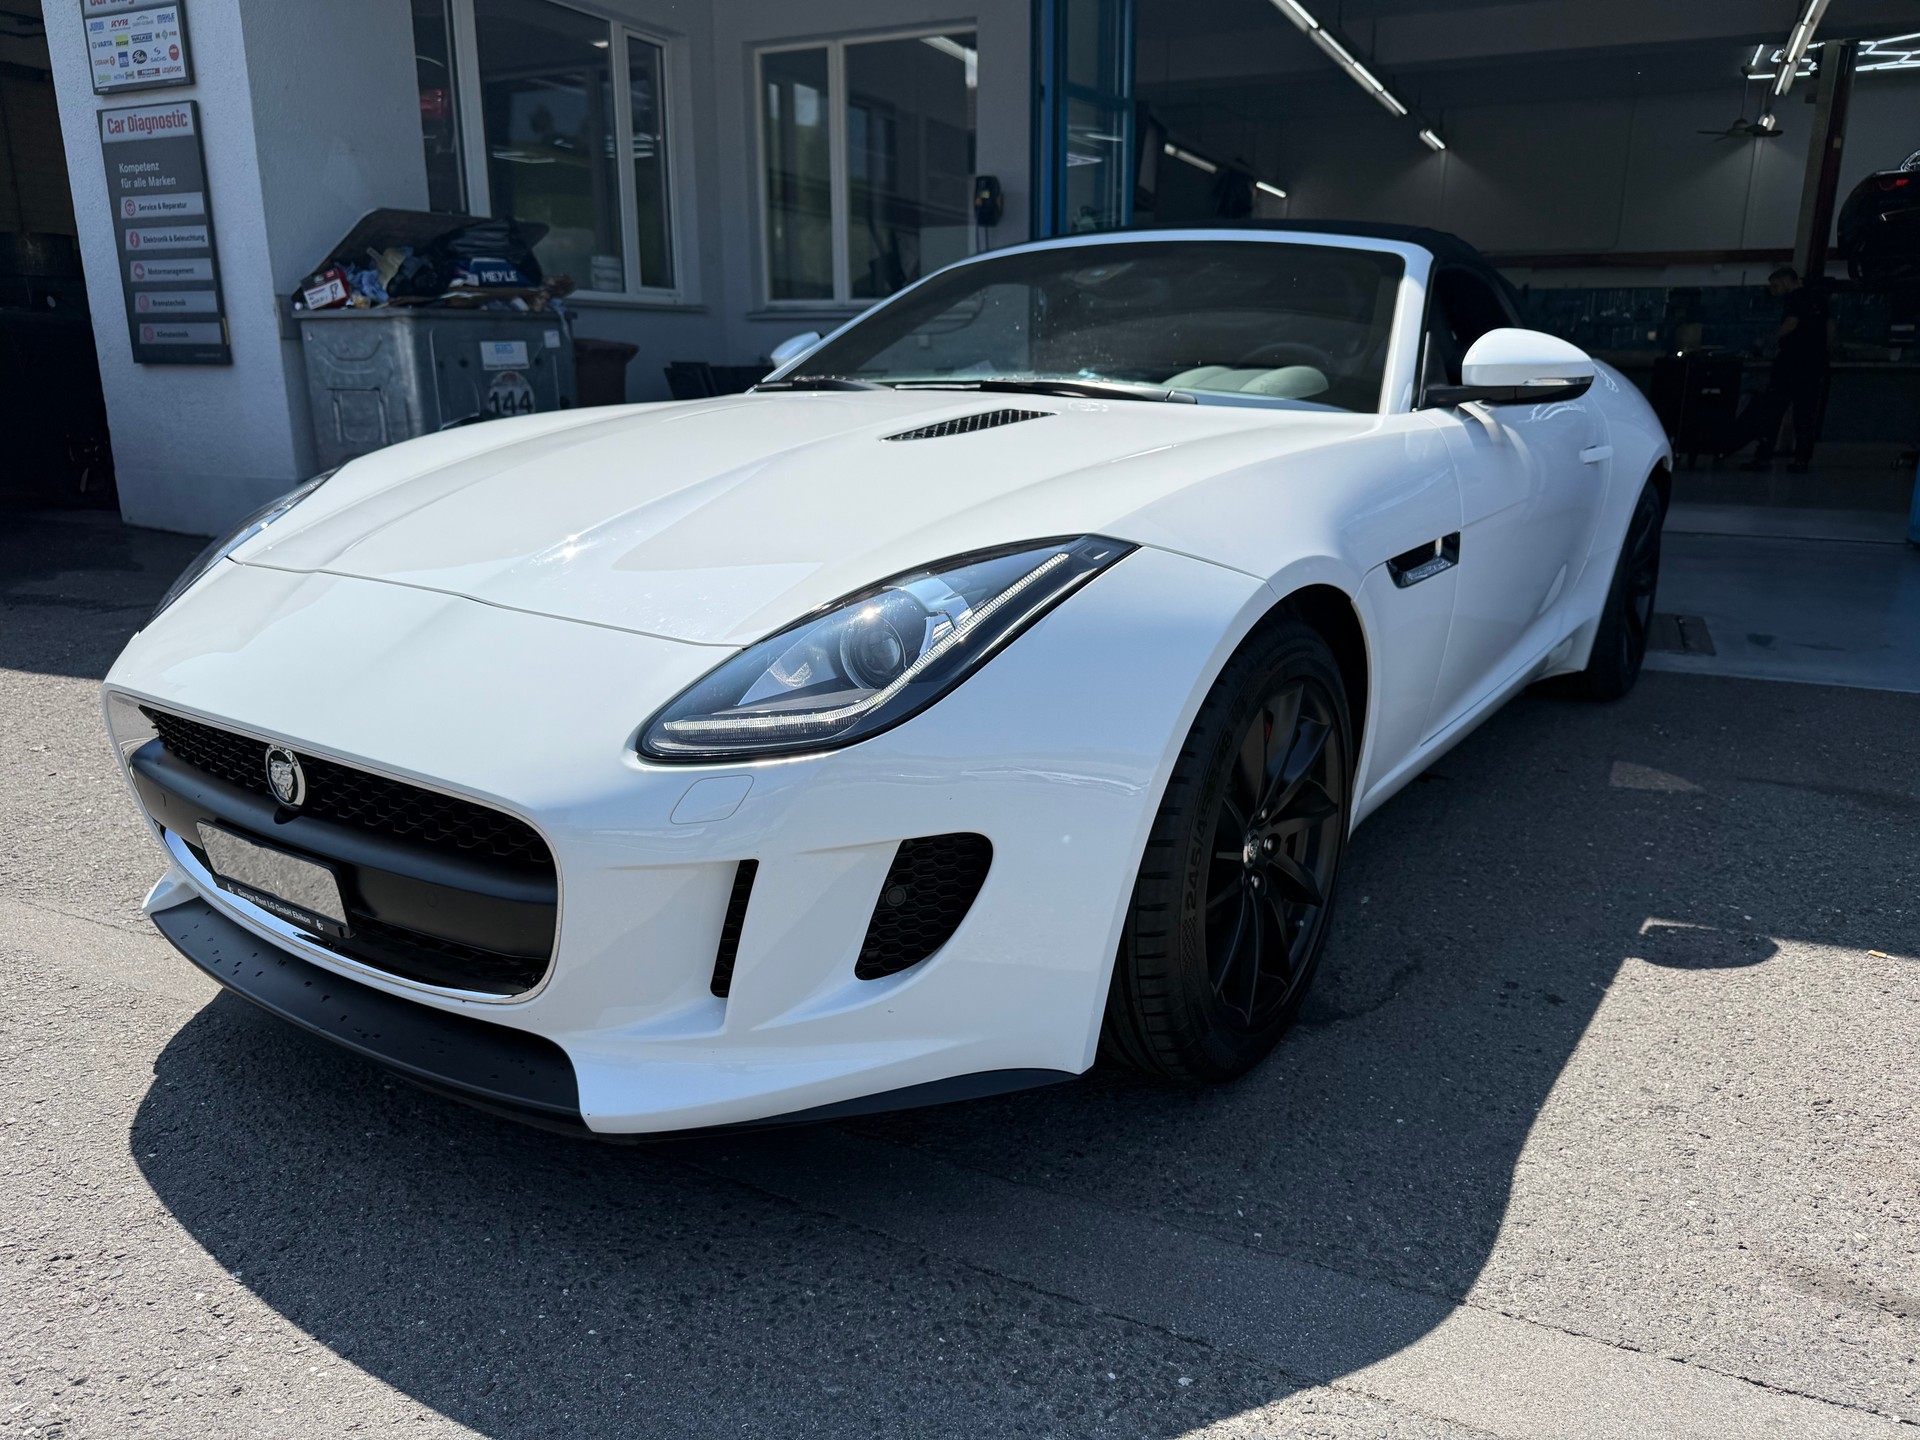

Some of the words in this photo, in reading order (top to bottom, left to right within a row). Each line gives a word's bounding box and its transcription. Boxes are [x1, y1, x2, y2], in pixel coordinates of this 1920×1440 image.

[97, 40, 113, 48] VARTA
[107, 118, 126, 134] Car
[127, 109, 188, 135] Diagnostic
[118, 162, 160, 174] Kompetenz
[120, 177, 131, 189] für
[133, 177, 147, 188] alle
[148, 176, 176, 187] Marken
[138, 203, 157, 211] Service
[162, 202, 187, 211] Reparatur
[143, 235, 168, 243] Elektronik
[174, 234, 206, 243] Beleuchtung
[147, 267, 194, 276] Motormanagement
[480, 270, 518, 283] MEYLE
[488, 390, 533, 415] 144
